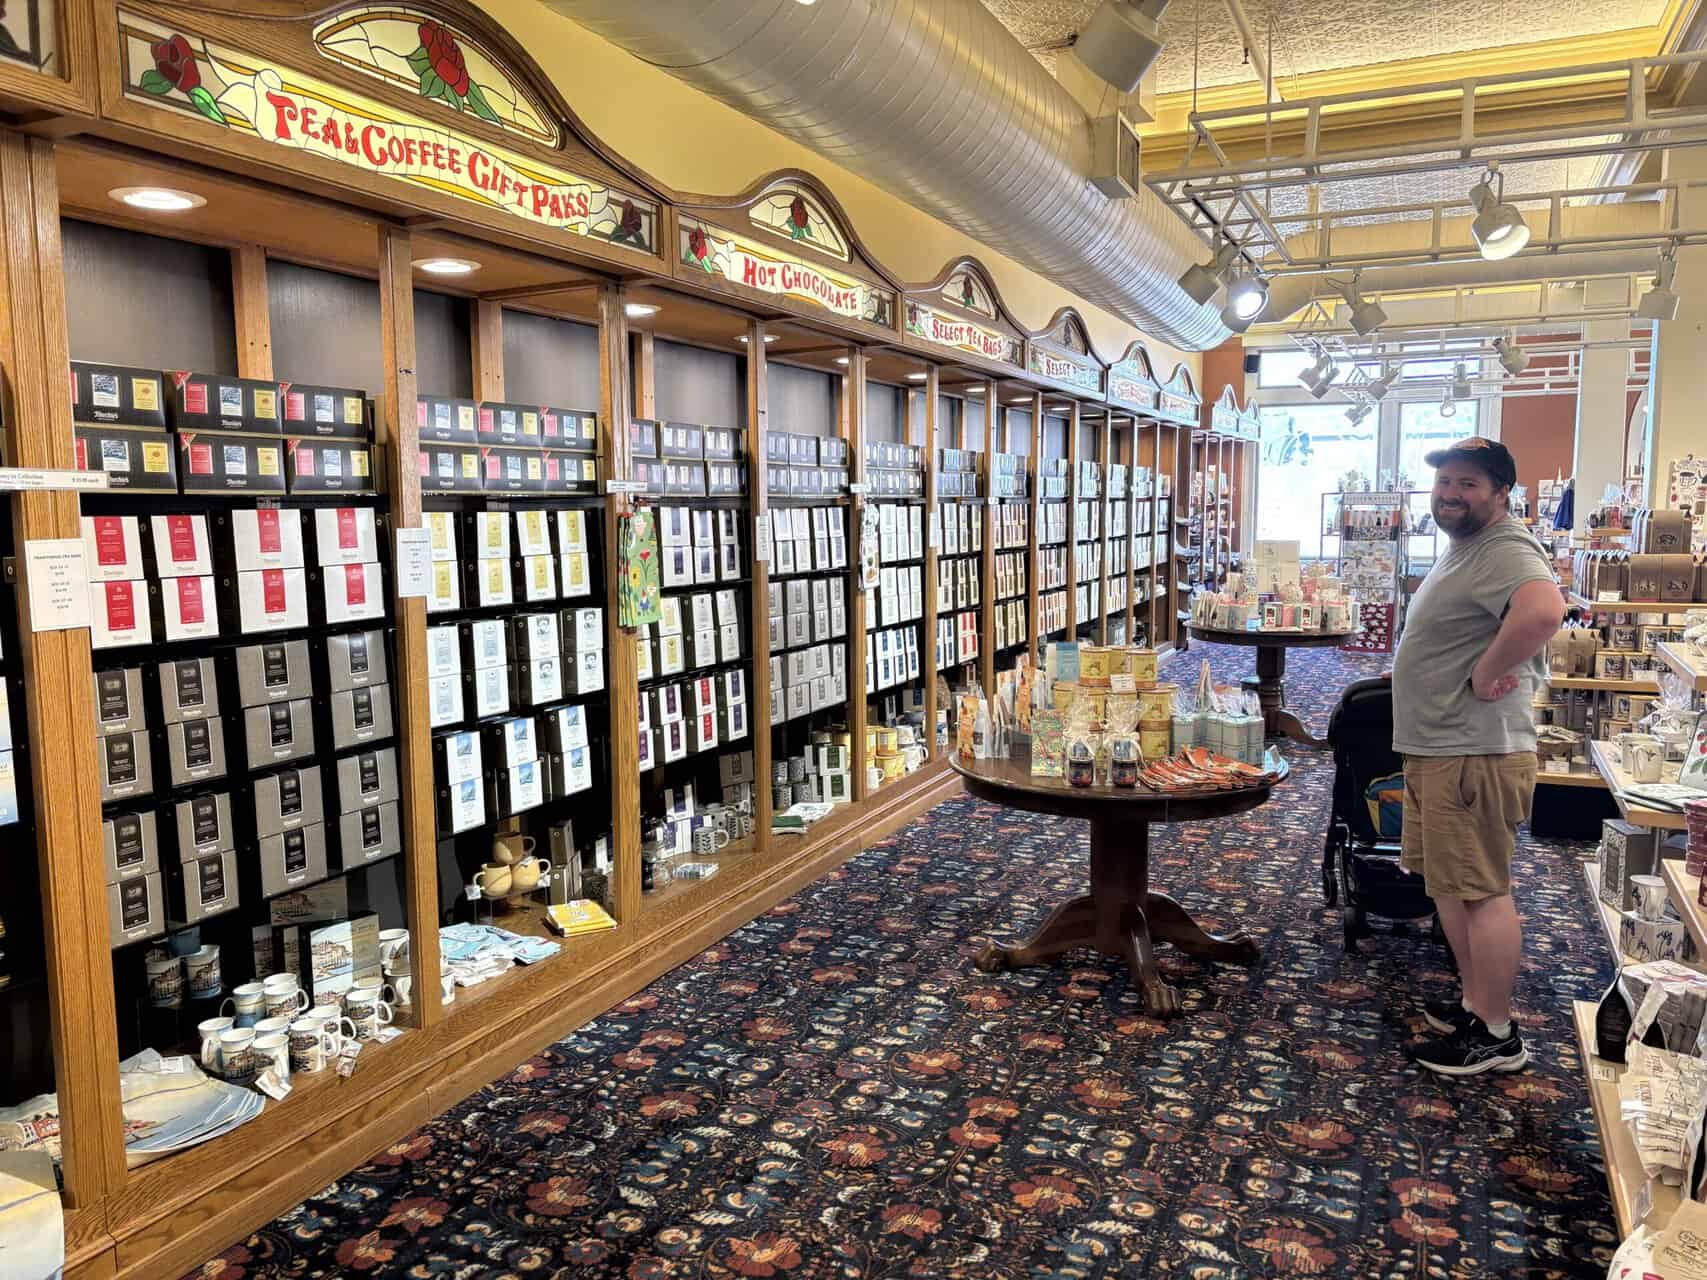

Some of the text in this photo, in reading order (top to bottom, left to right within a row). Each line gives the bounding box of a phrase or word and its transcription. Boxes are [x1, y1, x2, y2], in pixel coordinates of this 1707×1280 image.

[467, 151, 530, 208] GIFT
[530, 183, 590, 220] PAKS
[742, 255, 858, 311] HOT CHOCOLATE
[932, 318, 1003, 355] SELECT TEA BAGS
[1045, 358, 1072, 377] SELECT
